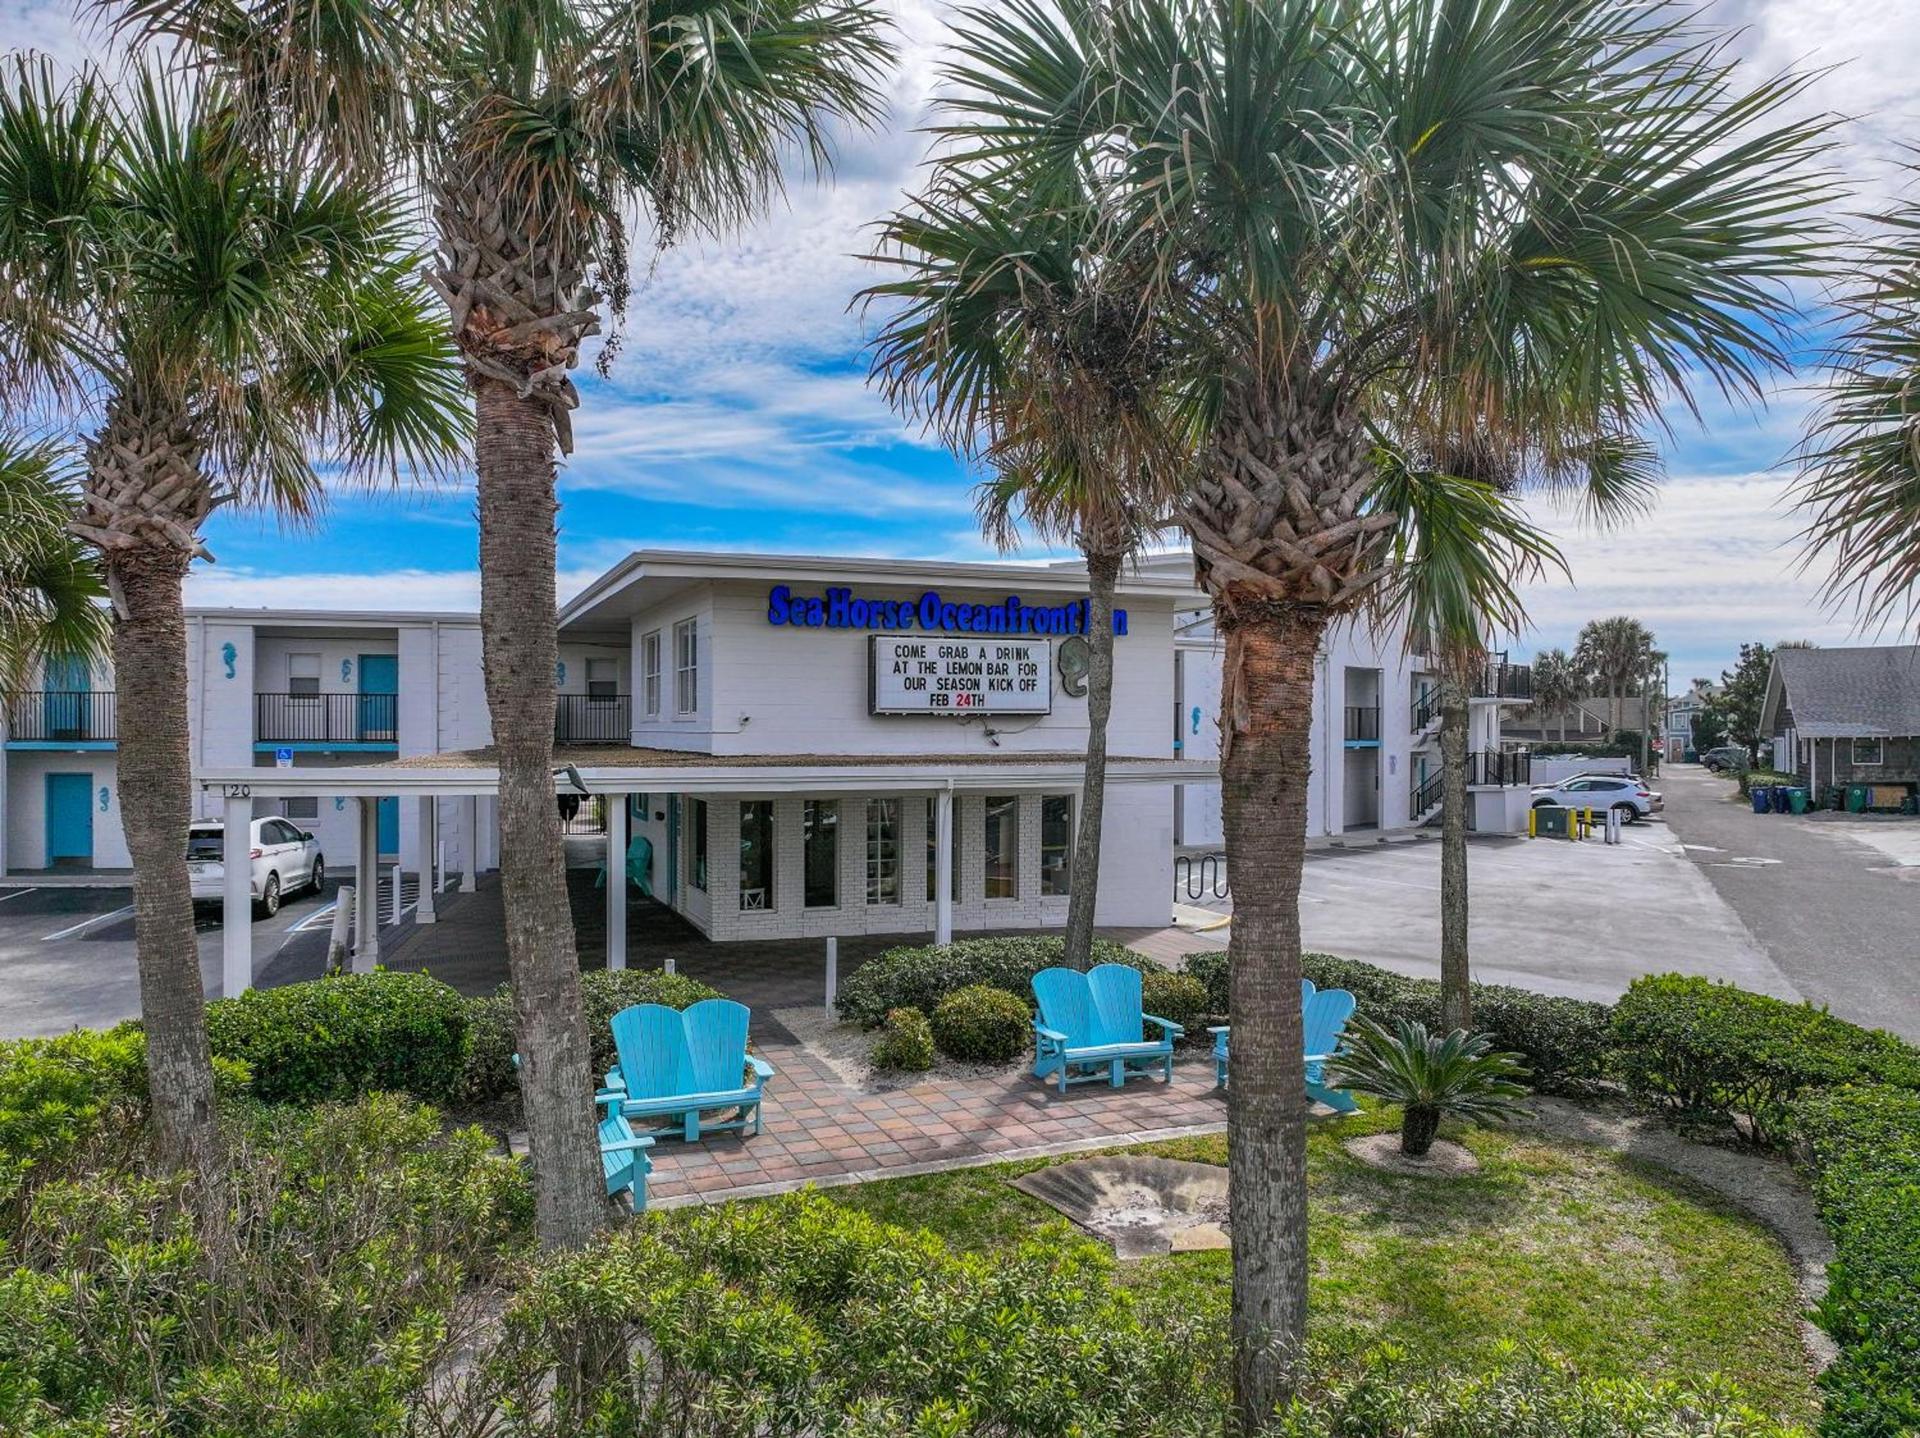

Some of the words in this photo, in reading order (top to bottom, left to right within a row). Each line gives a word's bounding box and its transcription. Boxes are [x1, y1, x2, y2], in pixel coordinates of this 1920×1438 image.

[768, 585, 823, 627] Sea
[826, 587, 915, 630] Horse
[919, 591, 1080, 636] Oceanfront
[1081, 597, 1128, 636] In
[895, 645, 926, 659] COME
[938, 646, 969, 659] GRAB
[979, 647, 987, 660] A
[996, 647, 1030, 660] DRINK
[893, 661, 908, 674] AT
[917, 661, 937, 675] THE
[946, 661, 983, 675] LEMON
[986, 662, 1009, 676] BAR
[1018, 663, 1038, 676] FOR
[904, 677, 927, 691] OUR
[936, 677, 981, 691] SEASON
[988, 678, 1014, 692] KICK
[1019, 678, 1038, 692] OFF
[929, 693, 949, 707] FEB
[956, 693, 985, 707] 24TH
[223, 784, 251, 798] 120
